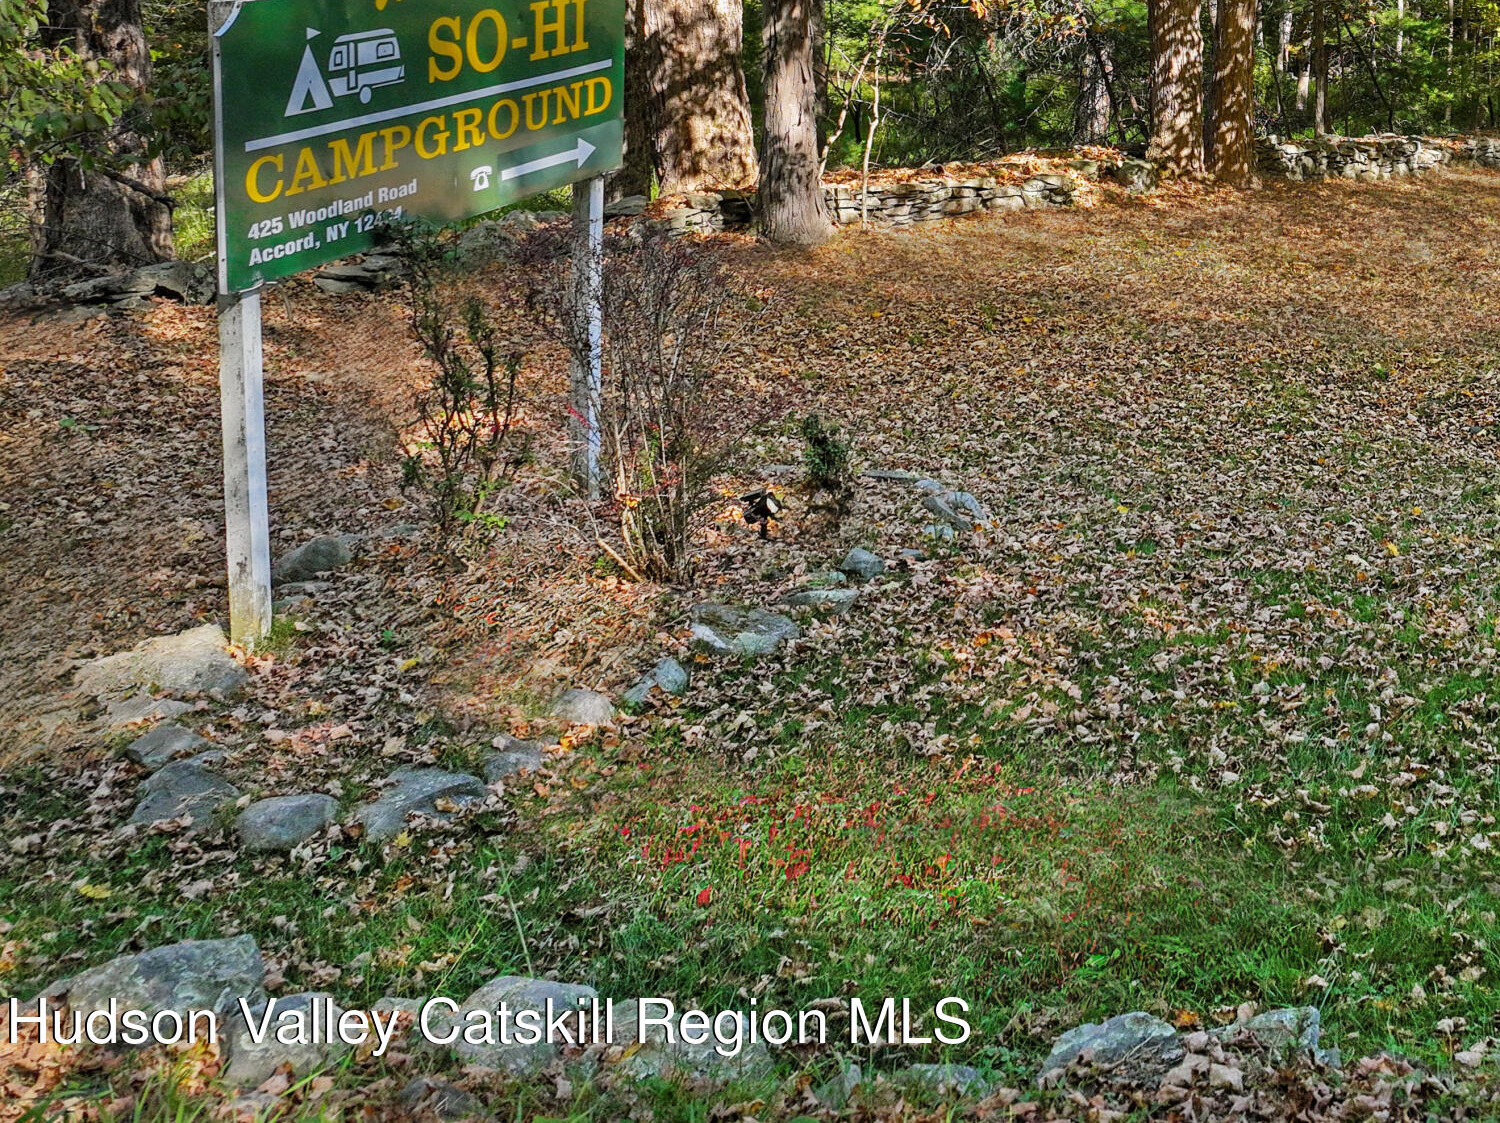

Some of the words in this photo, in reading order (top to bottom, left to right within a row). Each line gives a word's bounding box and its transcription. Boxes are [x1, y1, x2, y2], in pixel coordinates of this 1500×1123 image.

[244, 76, 612, 203] CAMPGROUND
[248, 216, 283, 240] 425
[288, 191, 373, 229] Woodland
[378, 179, 417, 203] Road
[249, 232, 321, 267] Accord,
[326, 221, 350, 243] NY
